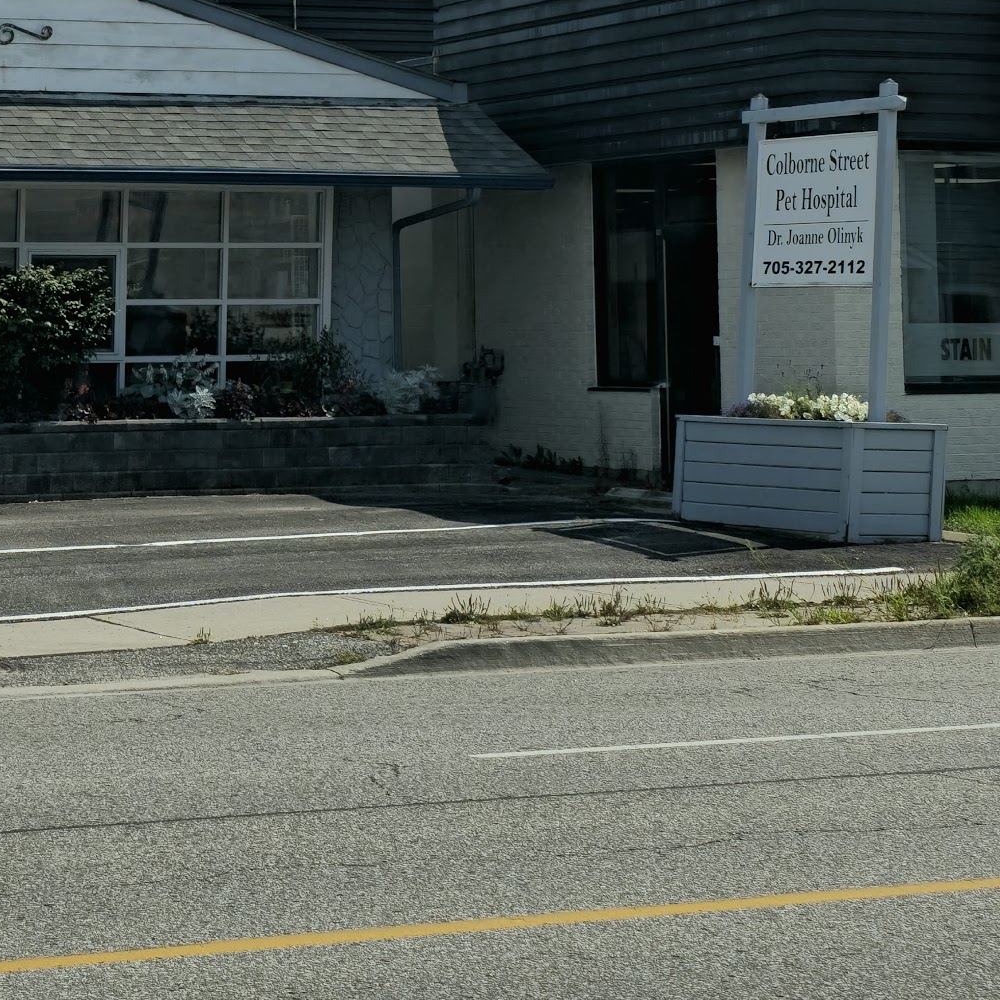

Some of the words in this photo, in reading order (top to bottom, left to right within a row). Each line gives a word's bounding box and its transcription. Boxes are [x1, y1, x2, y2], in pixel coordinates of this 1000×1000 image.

[766, 152, 825, 176] Colborne
[829, 149, 870, 172] Street
[775, 189, 797, 211] Pet
[801, 185, 858, 217] Hospital
[767, 229, 783, 246] Dr.
[786, 229, 824, 246] Joanne
[827, 226, 864, 249] Olinyk
[763, 260, 865, 275] 705-327-2112
[940, 338, 992, 361] STAIN
